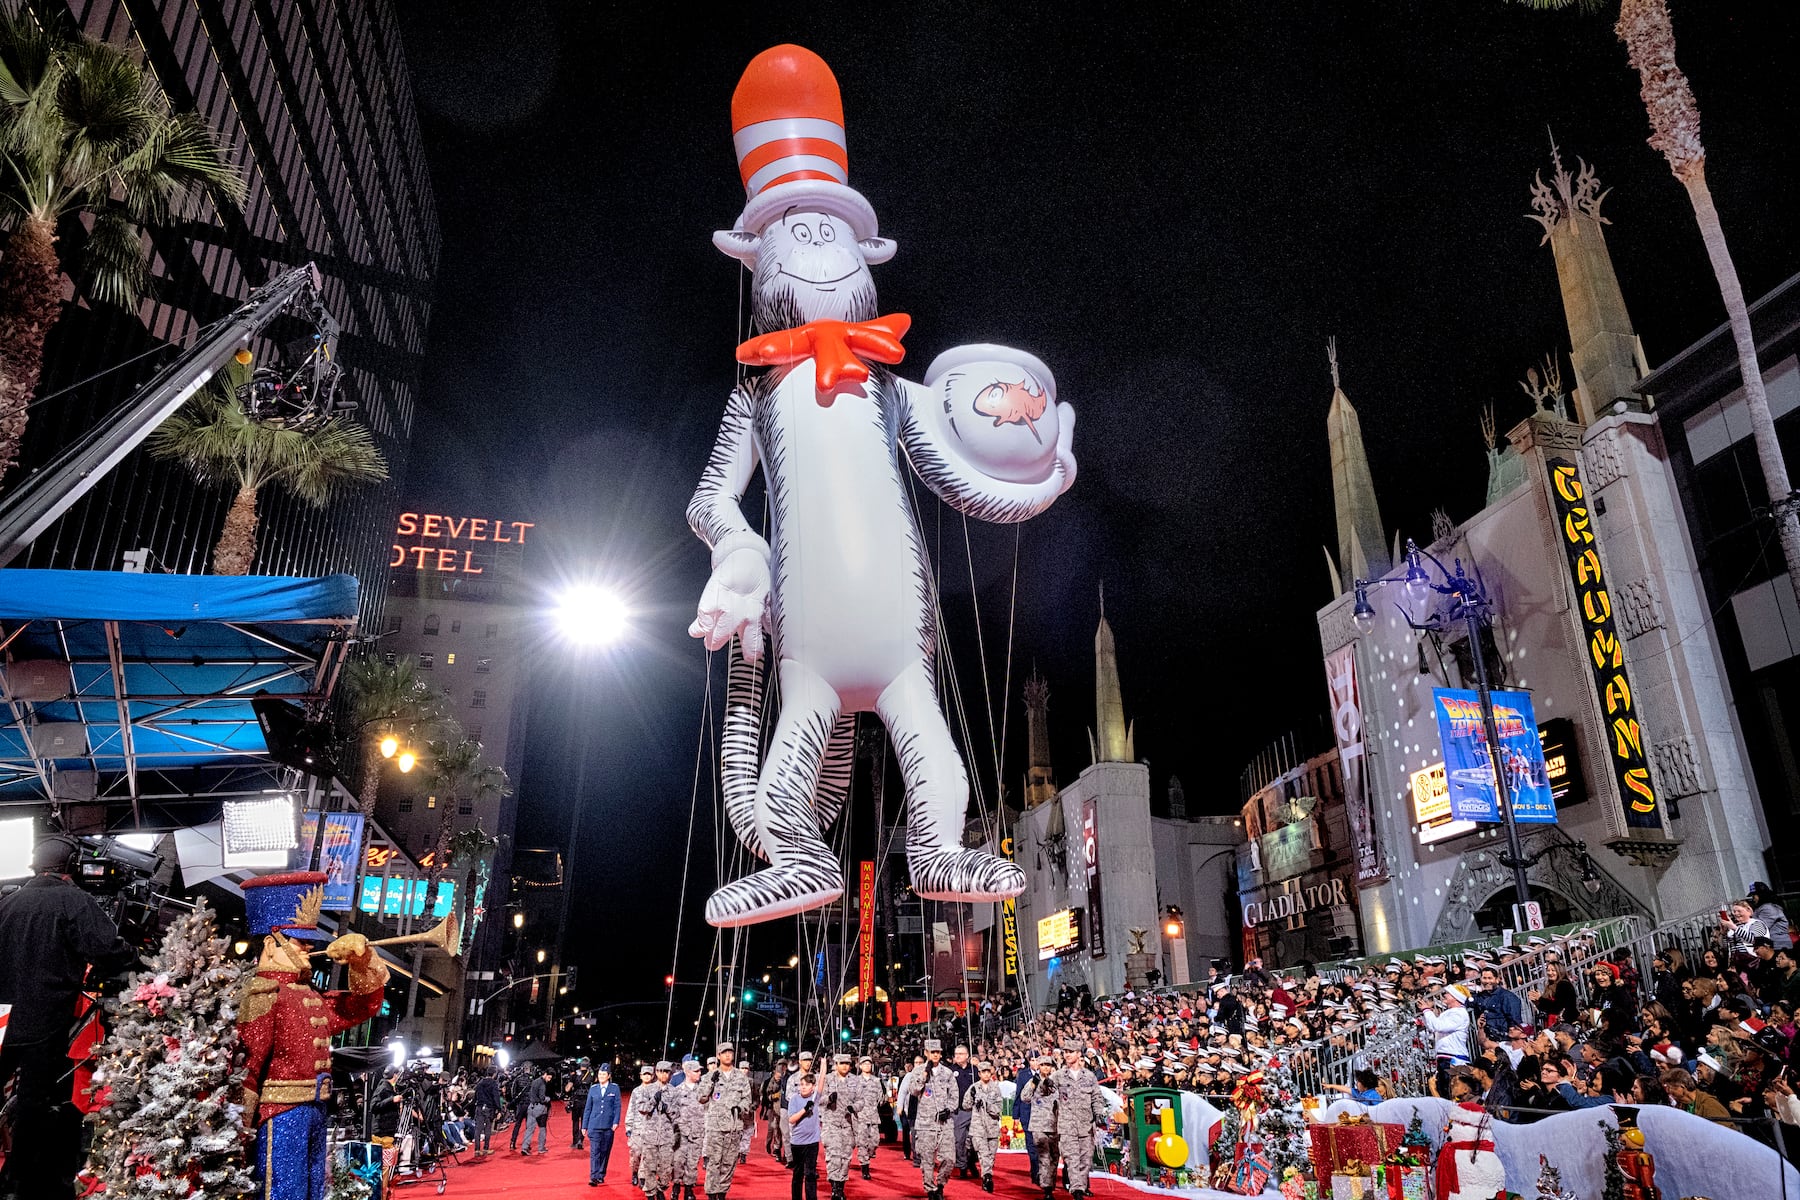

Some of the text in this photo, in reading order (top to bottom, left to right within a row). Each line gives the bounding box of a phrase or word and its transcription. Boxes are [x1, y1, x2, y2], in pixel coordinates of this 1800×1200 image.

[397, 512, 535, 544] SEVELT
[1554, 466, 1655, 813] GRAUMANS
[1333, 657, 1364, 779] TCL
[863, 864, 871, 919] MADAME
[1359, 867, 1380, 880] IMAX
[1001, 838, 1017, 975] CNESE
[1244, 878, 1347, 929] GLADIATOR
[1476, 941, 1493, 949] THE
